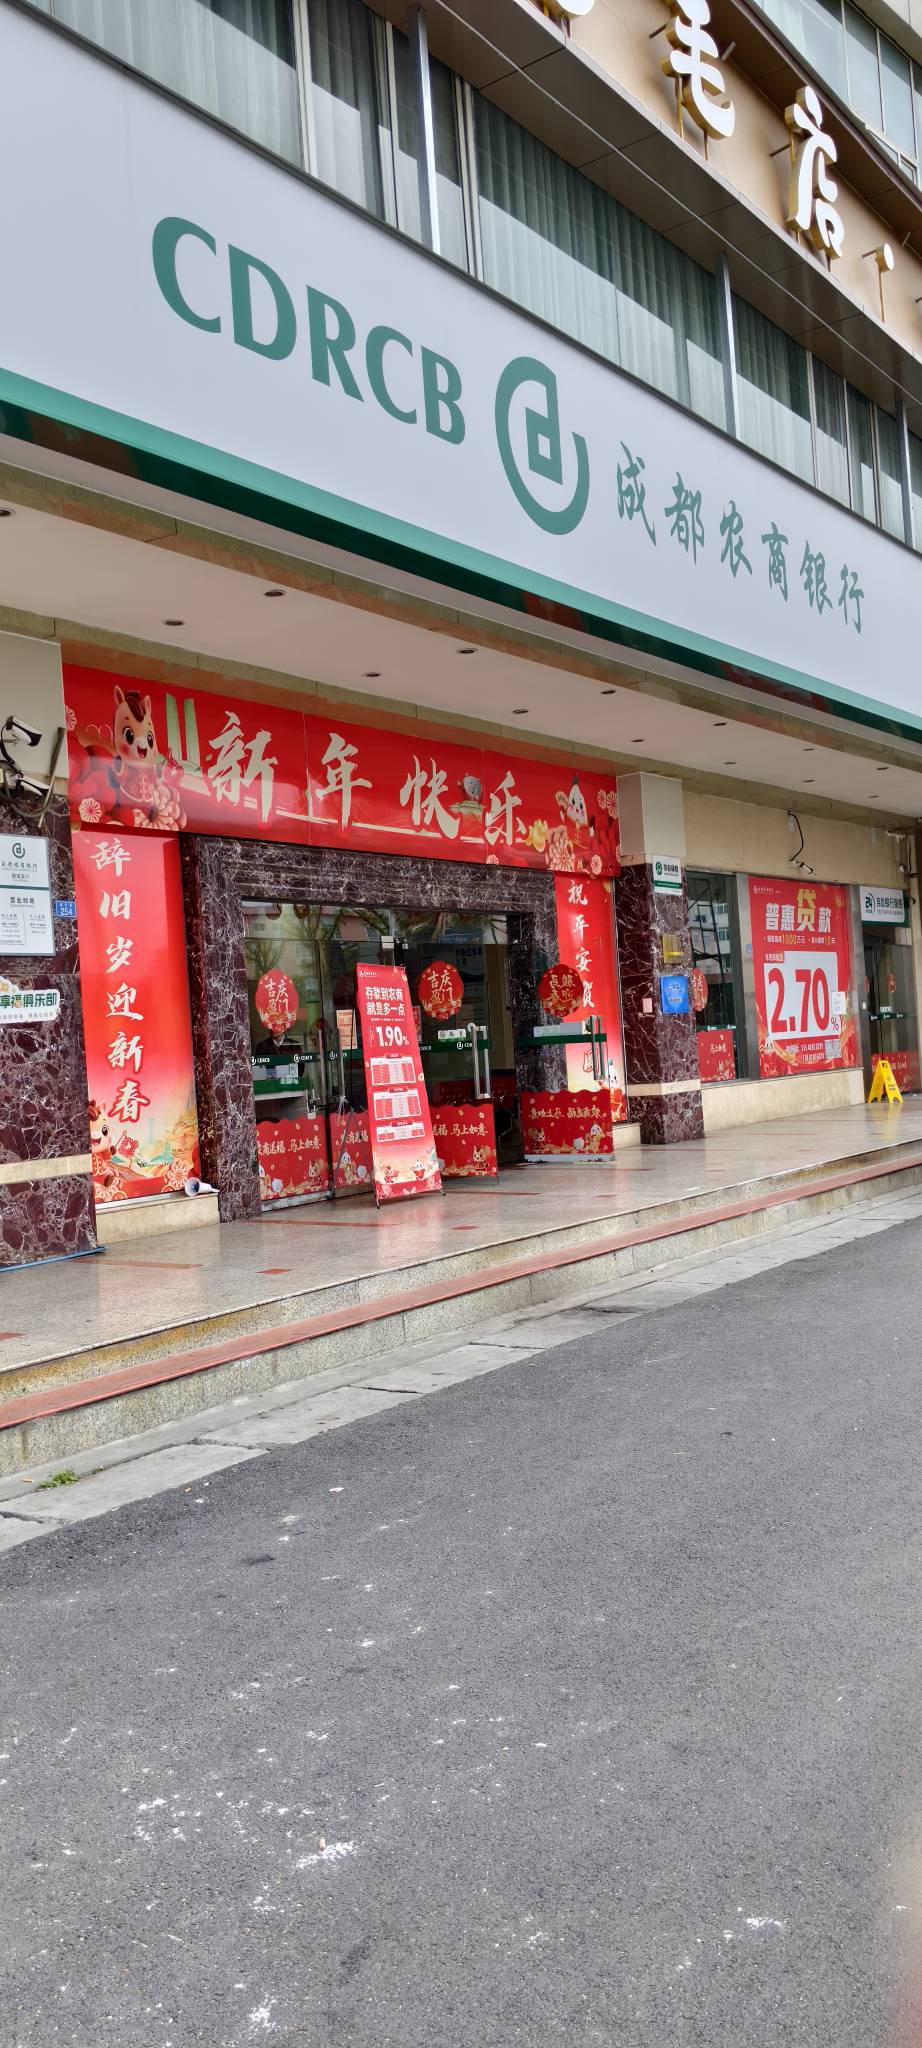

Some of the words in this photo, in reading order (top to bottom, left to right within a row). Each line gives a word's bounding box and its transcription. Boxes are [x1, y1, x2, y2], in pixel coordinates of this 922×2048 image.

[152, 216, 466, 445] CDRCB
[616, 440, 865, 635] 成都农商银行
[206, 710, 524, 846] 新年快乐
[60, 907, 73, 916] 254
[765, 888, 832, 933] 普惠贷款
[90, 837, 149, 1124] 辞旧岁迎新春
[365, 986, 404, 1001] 存款到农商
[366, 1001, 406, 1016] 就是多一点
[288, 1135, 322, 1152] 马上如意
[450, 1122, 488, 1137] 马上如意
